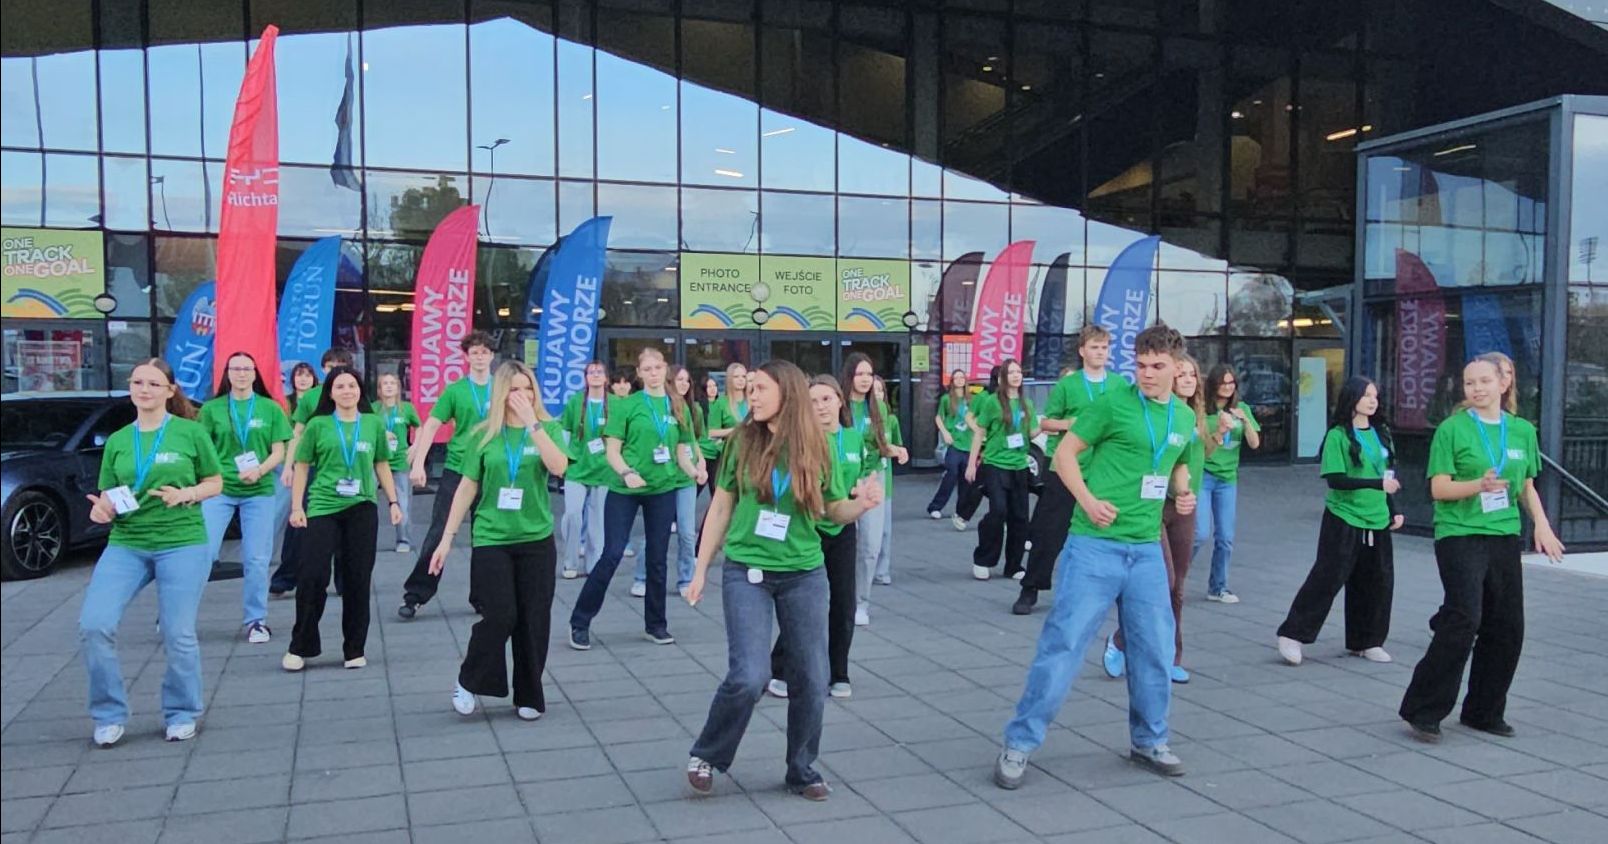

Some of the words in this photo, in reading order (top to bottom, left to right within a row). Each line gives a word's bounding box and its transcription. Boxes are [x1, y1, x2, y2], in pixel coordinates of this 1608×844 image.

[3, 237, 34, 250] ONE
[3, 245, 74, 266] TRACK
[34, 257, 97, 278] GOAL
[700, 268, 740, 279] PHOTO
[774, 270, 822, 281] WEJŚCIE
[841, 268, 863, 279] ONE
[689, 282, 751, 293] ENTRANCE
[783, 285, 814, 295] FOTO
[842, 274, 890, 292] TRACK
[862, 284, 905, 301] GOAL
[285, 282, 304, 347] MIASTO
[297, 265, 324, 352] TORUŃ
[443, 268, 469, 384] OMORZE
[420, 285, 445, 403] KUJAWY
[1119, 288, 1144, 385] OMORZE
[543, 289, 570, 404] KUJAWY
